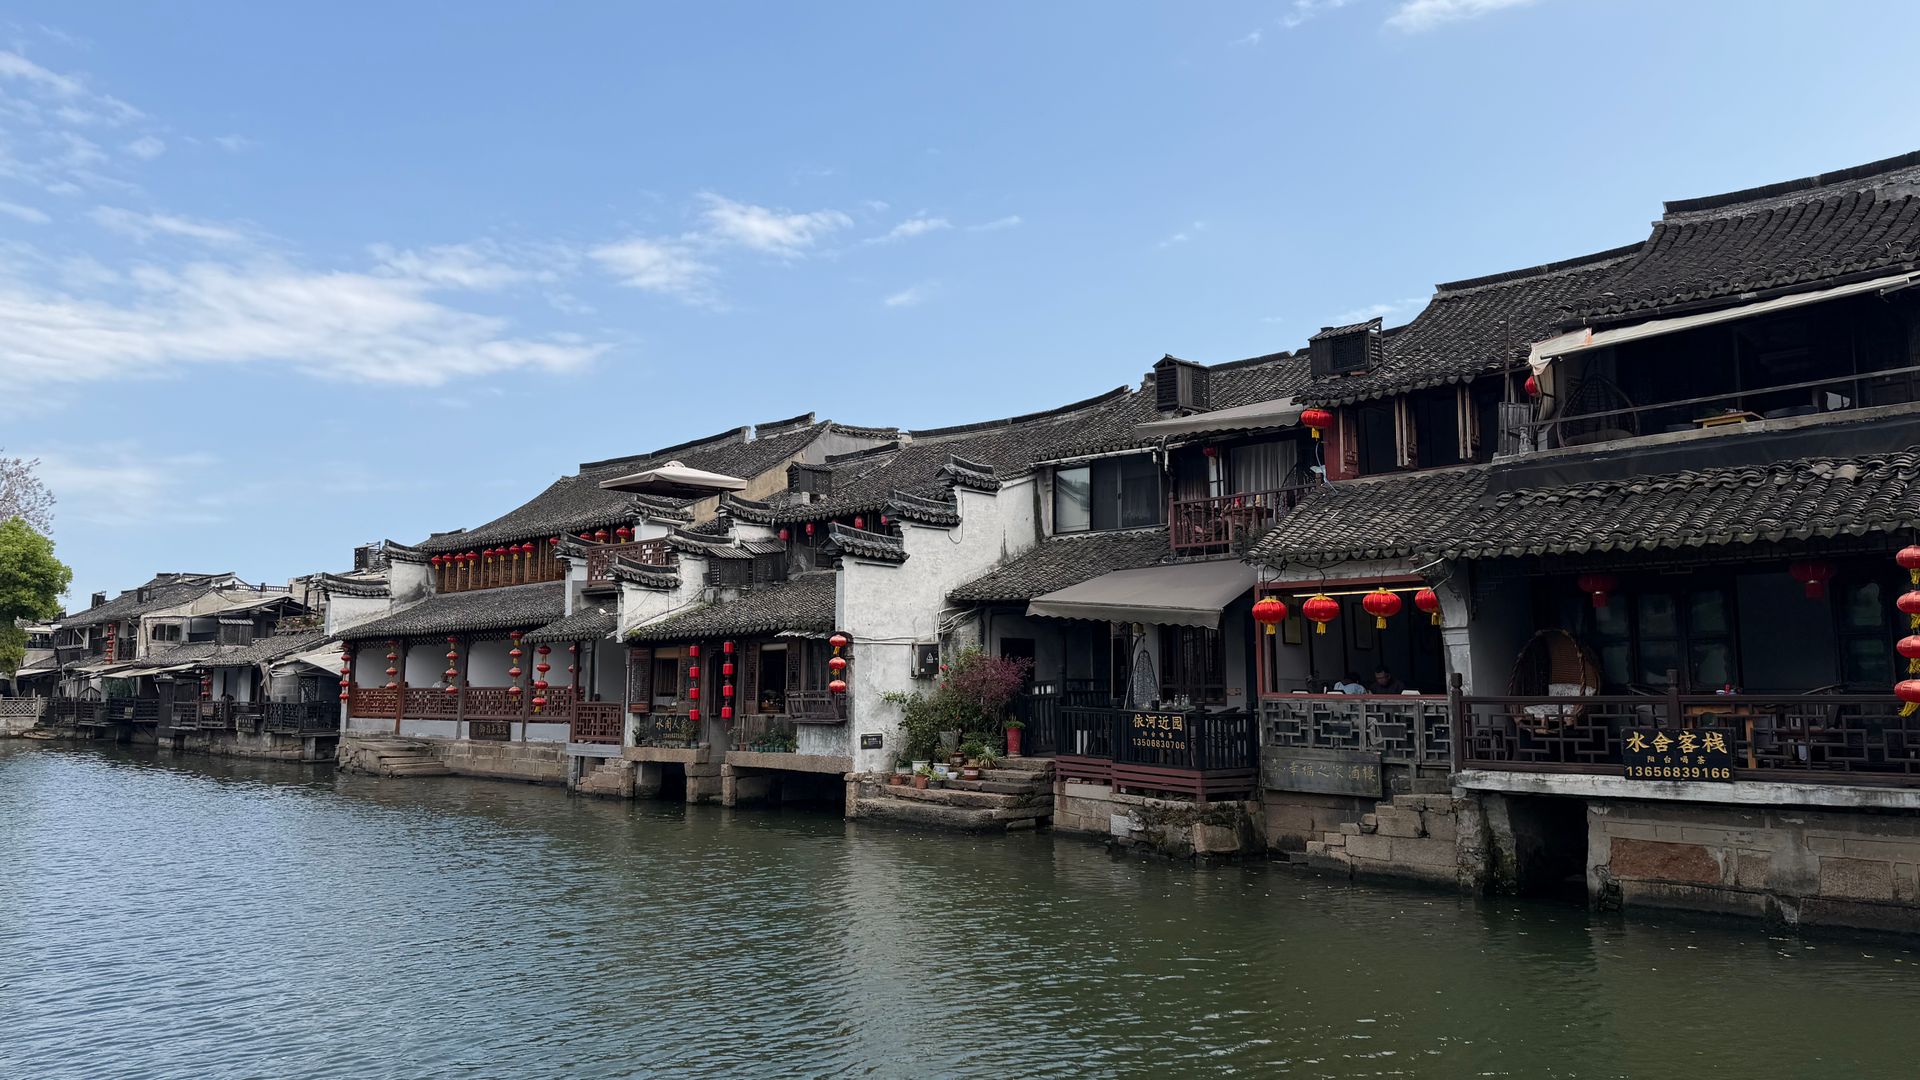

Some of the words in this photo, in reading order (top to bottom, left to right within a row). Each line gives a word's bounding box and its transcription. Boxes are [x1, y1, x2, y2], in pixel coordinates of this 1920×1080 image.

[1133, 713, 1183, 731] 依河近园
[1132, 738, 1185, 750] 13506830706
[1625, 731, 1728, 754] 水舍客栈
[1646, 755, 1706, 765] 阳台喝茶
[1625, 766, 1730, 779] 13656839166
